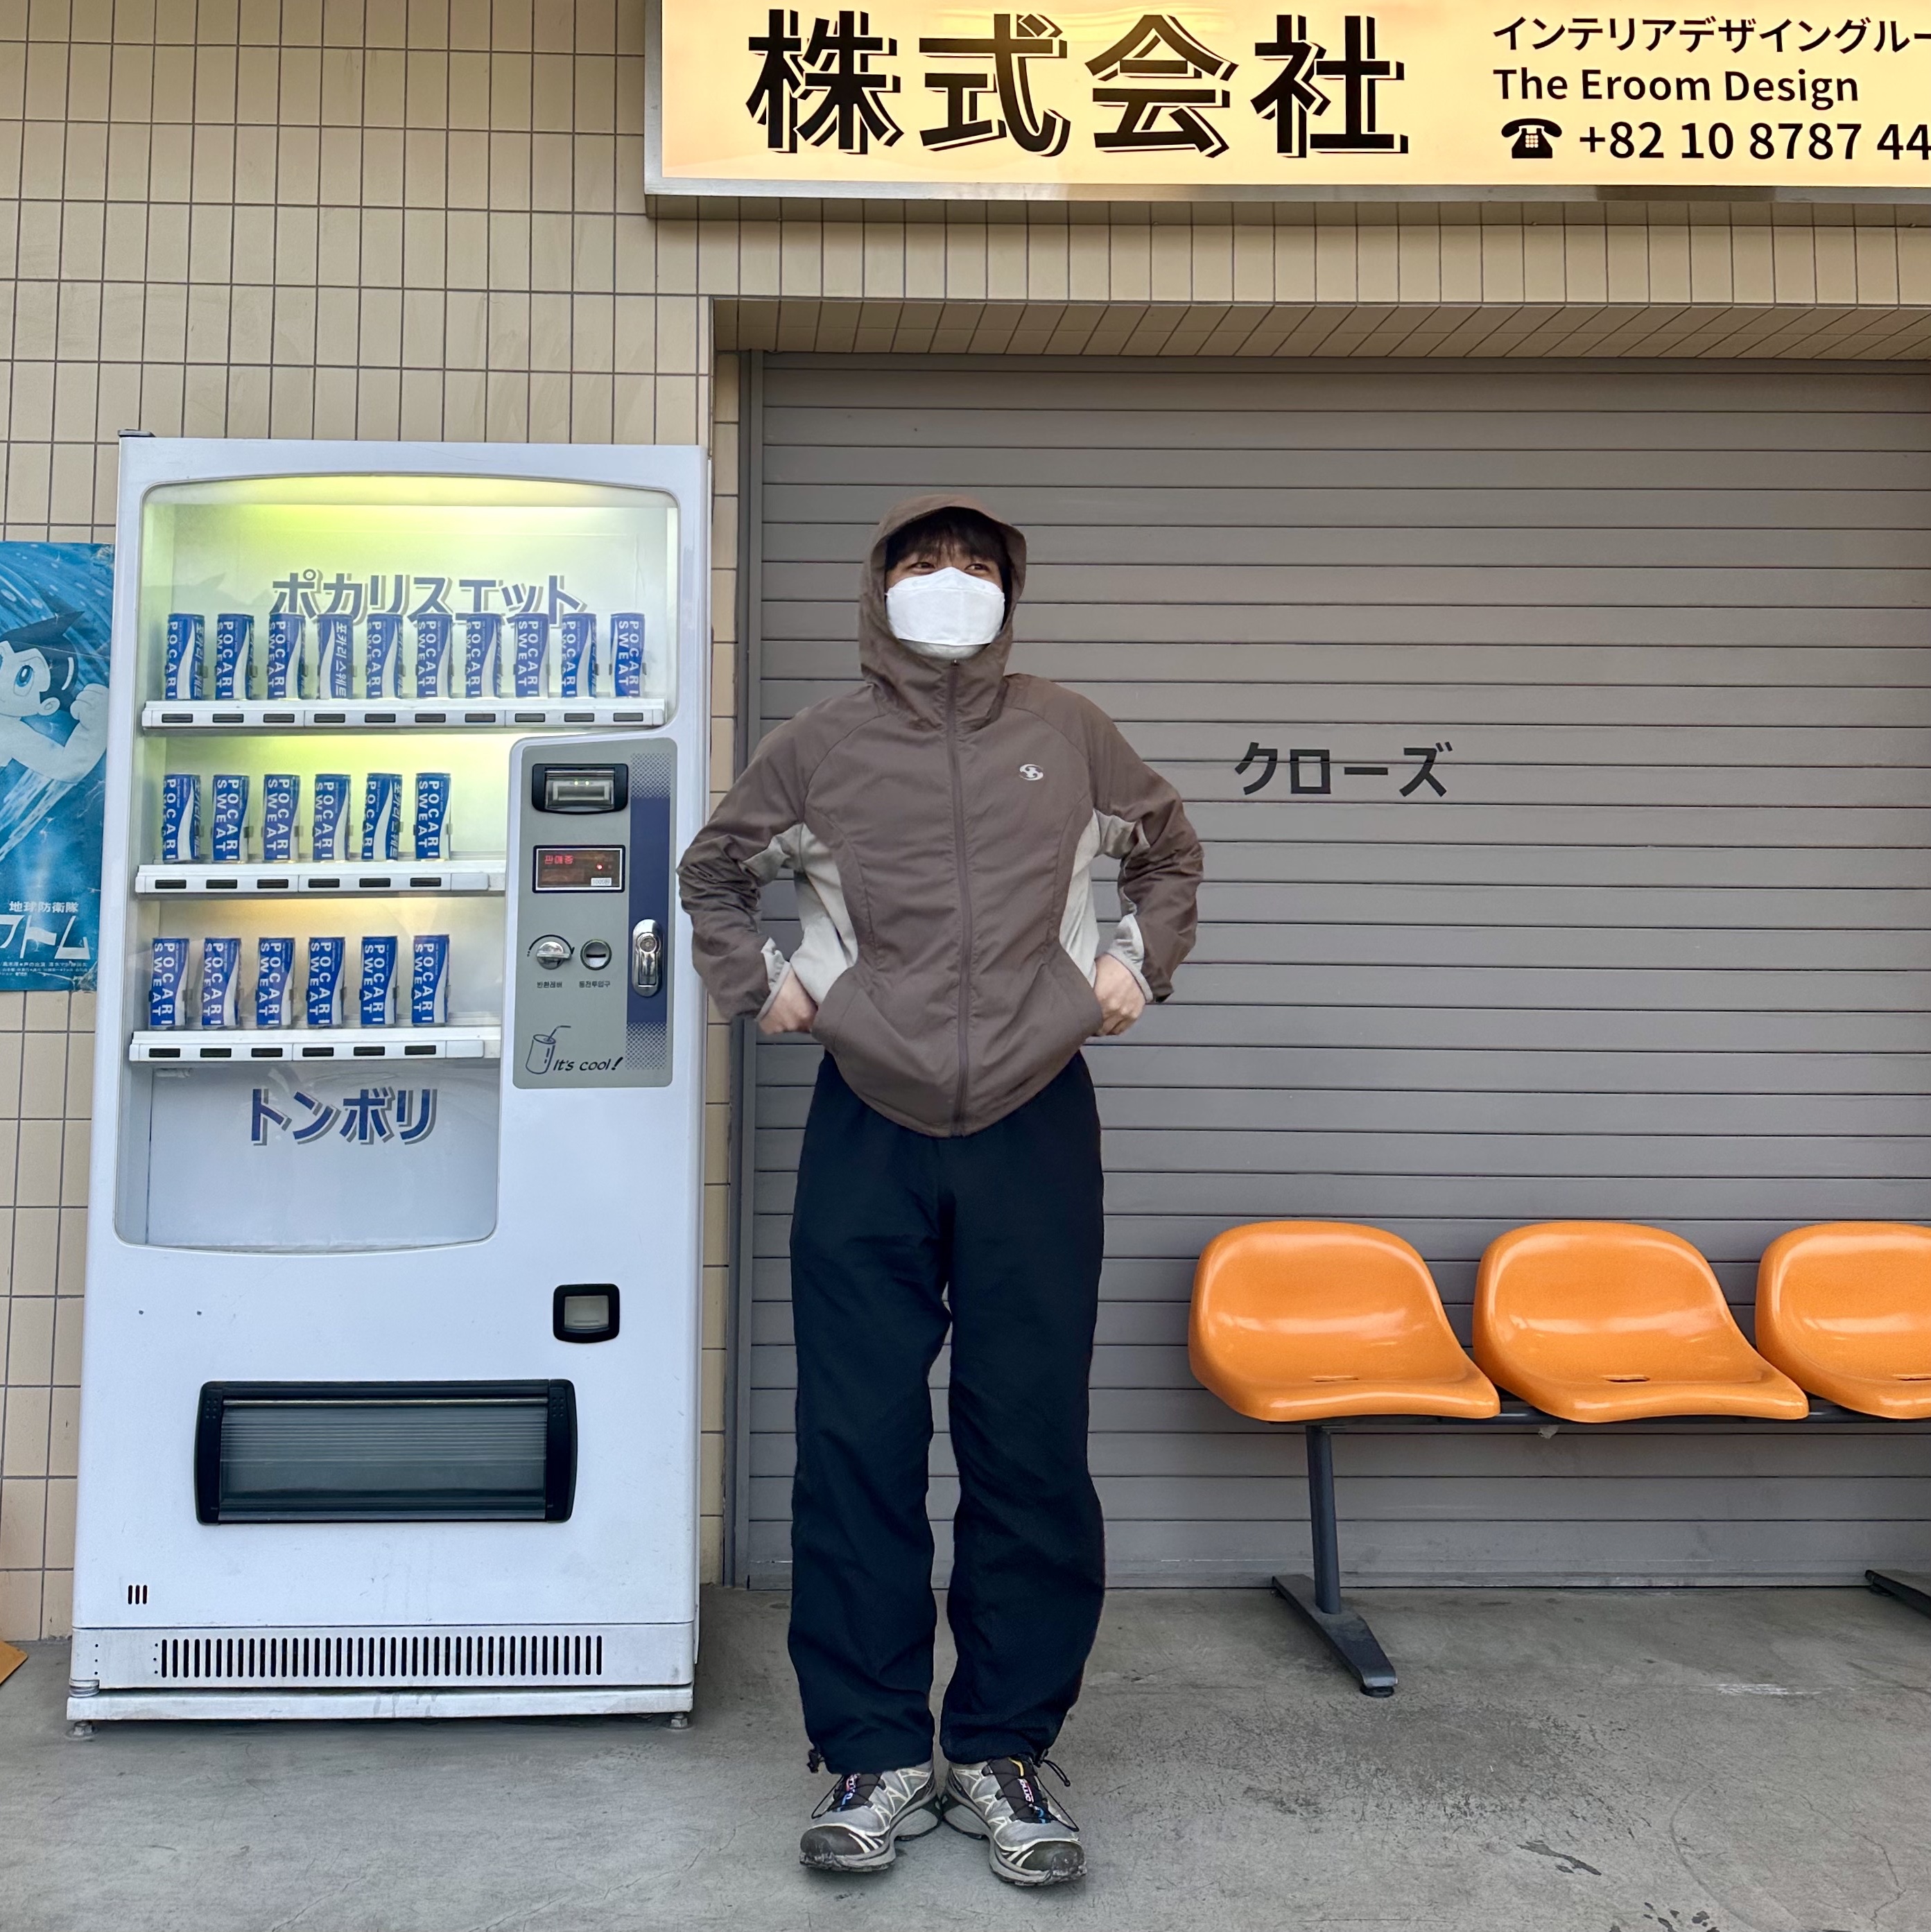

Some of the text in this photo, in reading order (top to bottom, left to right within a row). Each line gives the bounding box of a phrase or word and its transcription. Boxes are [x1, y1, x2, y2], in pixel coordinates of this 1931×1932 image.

[745, 8, 1408, 158] 株式会社
[1493, 67, 1858, 110] The Eroom Design
[1579, 121, 1931, 160] +82 10 8787 44
[167, 621, 178, 696] POCARI
[222, 621, 234, 696] POCARI
[274, 621, 286, 695] POCARI
[371, 621, 381, 695] POCARI
[426, 620, 436, 695] POCARI
[471, 620, 481, 695] POCARI
[518, 620, 528, 686] SWEAT
[528, 620, 539, 695] POCARI
[566, 620, 576, 695] POCARI
[618, 620, 629, 685] SWEAT
[629, 620, 639, 694] POCARI
[1235, 742, 1453, 797] クローズ
[166, 778, 176, 859] POCARI
[216, 779, 227, 852] SWEAT
[226, 779, 239, 860] POCARI
[266, 778, 277, 851] SWEAT
[277, 778, 290, 859] POCARI
[322, 782, 334, 858] POCARI
[363, 781, 376, 857] POCARI
[418, 781, 428, 848] SWEAT
[427, 781, 440, 856] POCARI
[152, 943, 175, 1025] POCARI SWEAT
[210, 943, 223, 1025] POCARI
[259, 942, 282, 1025] POCARI SWEAT
[309, 942, 320, 1016] SWEAT
[318, 942, 331, 1024] POCARI
[363, 944, 374, 1013] SWEAT
[372, 944, 386, 1022] POCARI
[414, 943, 424, 1013] SWEAT
[422, 943, 434, 1021] POCARI
[553, 1059, 575, 1071] It's
[251, 1086, 438, 1146] トンボリ
